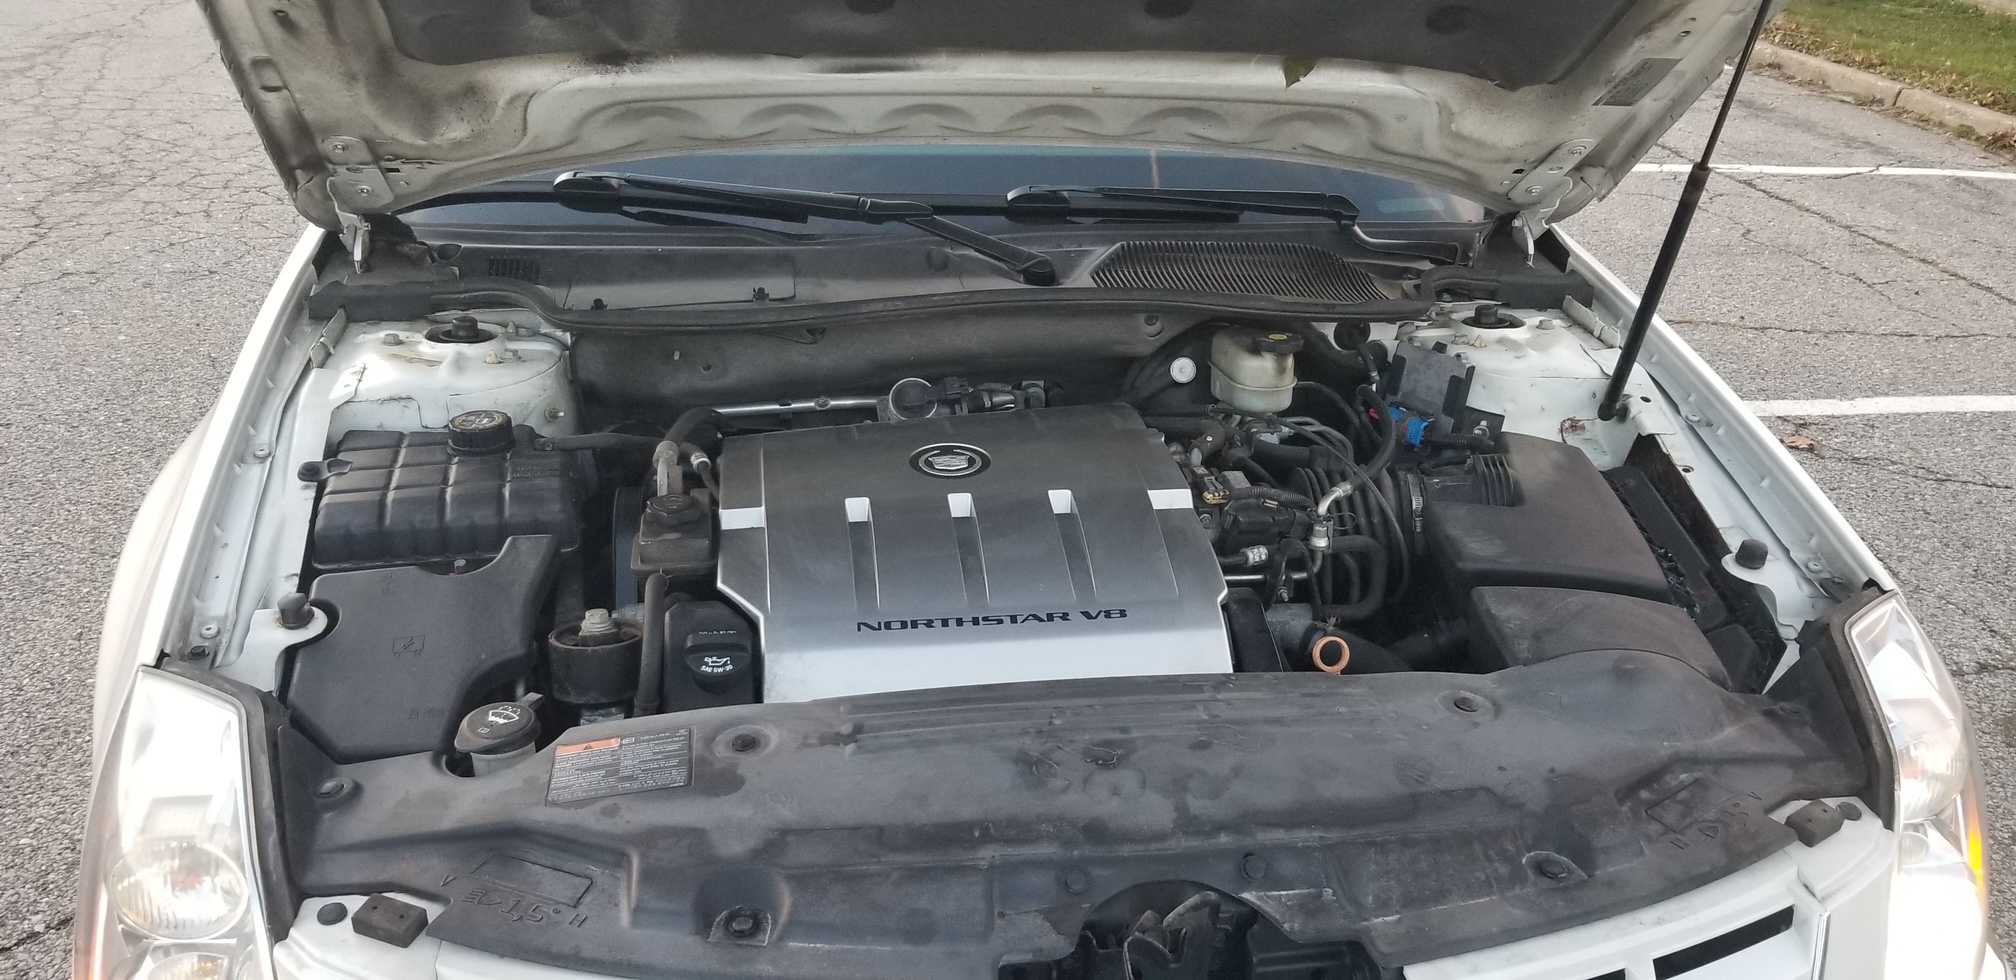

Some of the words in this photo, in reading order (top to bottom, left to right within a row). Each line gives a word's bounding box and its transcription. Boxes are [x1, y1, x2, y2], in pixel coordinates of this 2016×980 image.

[857, 612, 1072, 632] NORTHSTAR
[1079, 609, 1128, 620] V8
[701, 665, 713, 673] SAE
